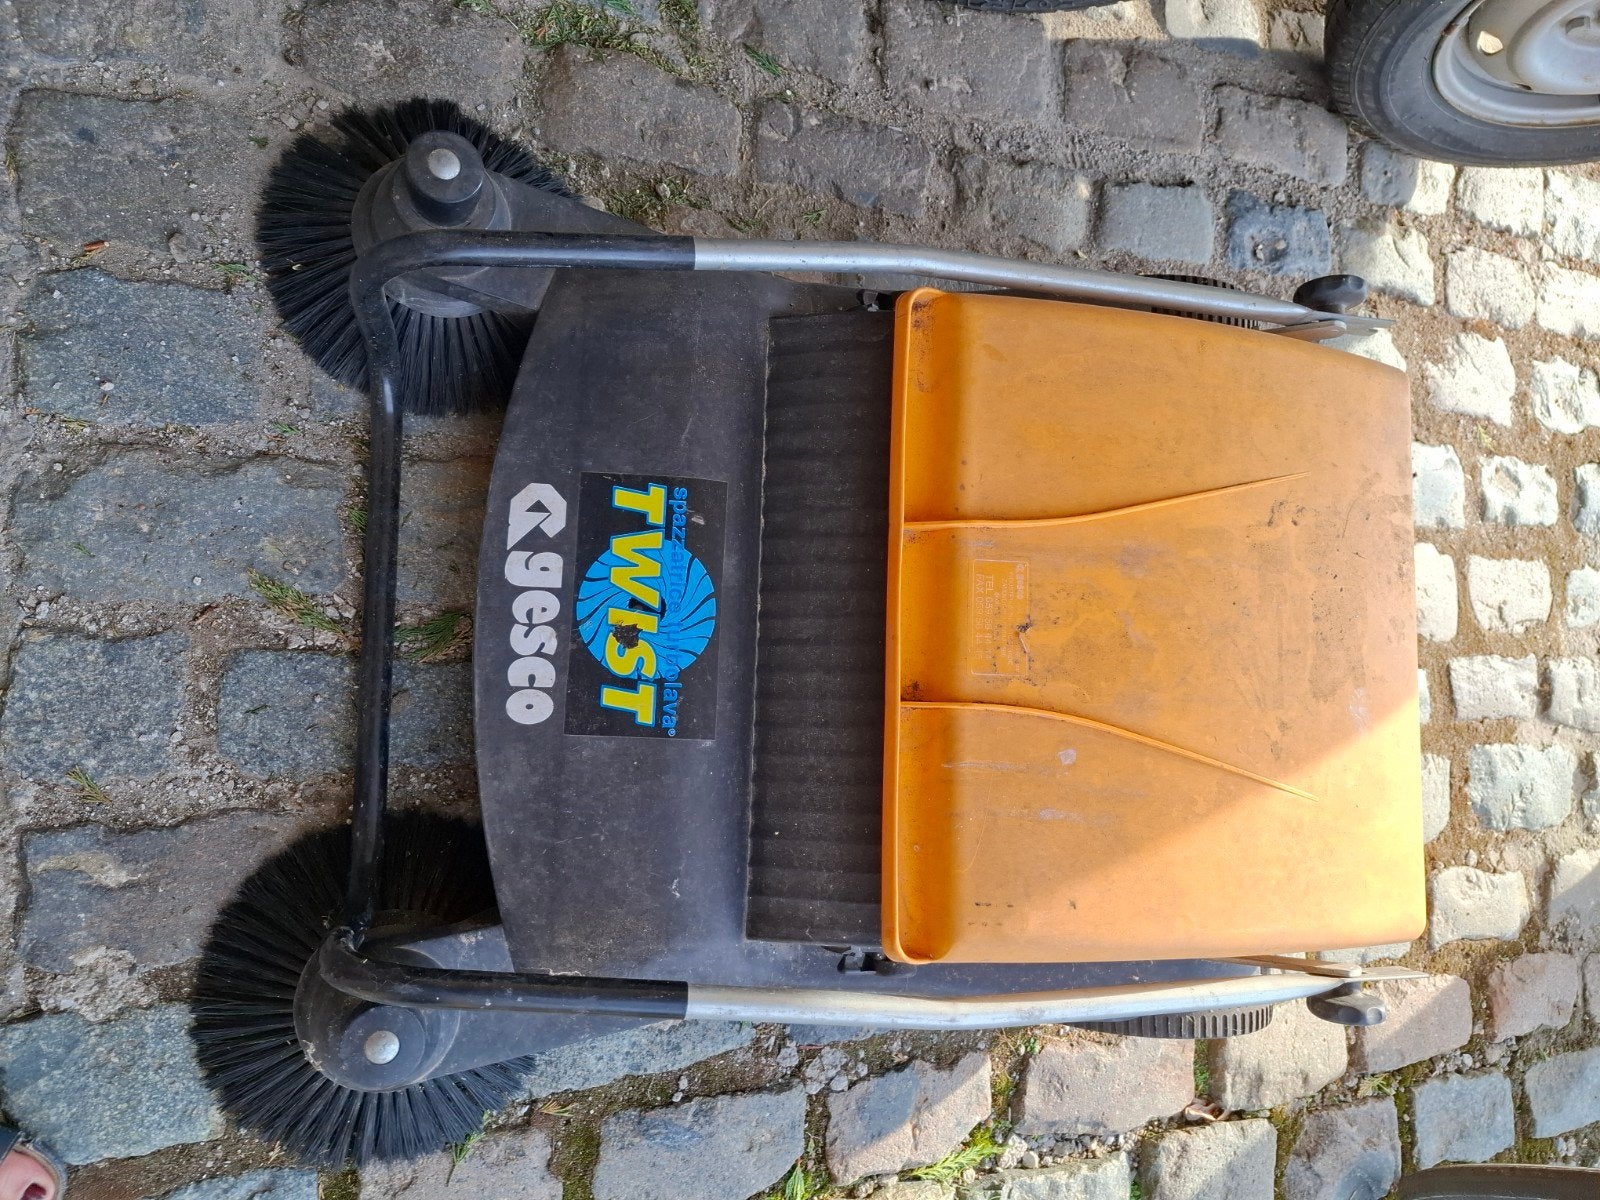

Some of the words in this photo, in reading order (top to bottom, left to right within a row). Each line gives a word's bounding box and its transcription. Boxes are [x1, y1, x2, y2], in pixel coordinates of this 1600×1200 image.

[600, 482, 667, 728] TWIST
[668, 486, 688, 610] spazzatrice
[975, 573, 985, 594] FAX
[985, 574, 994, 595] TEL
[504, 550, 564, 725] gesco
